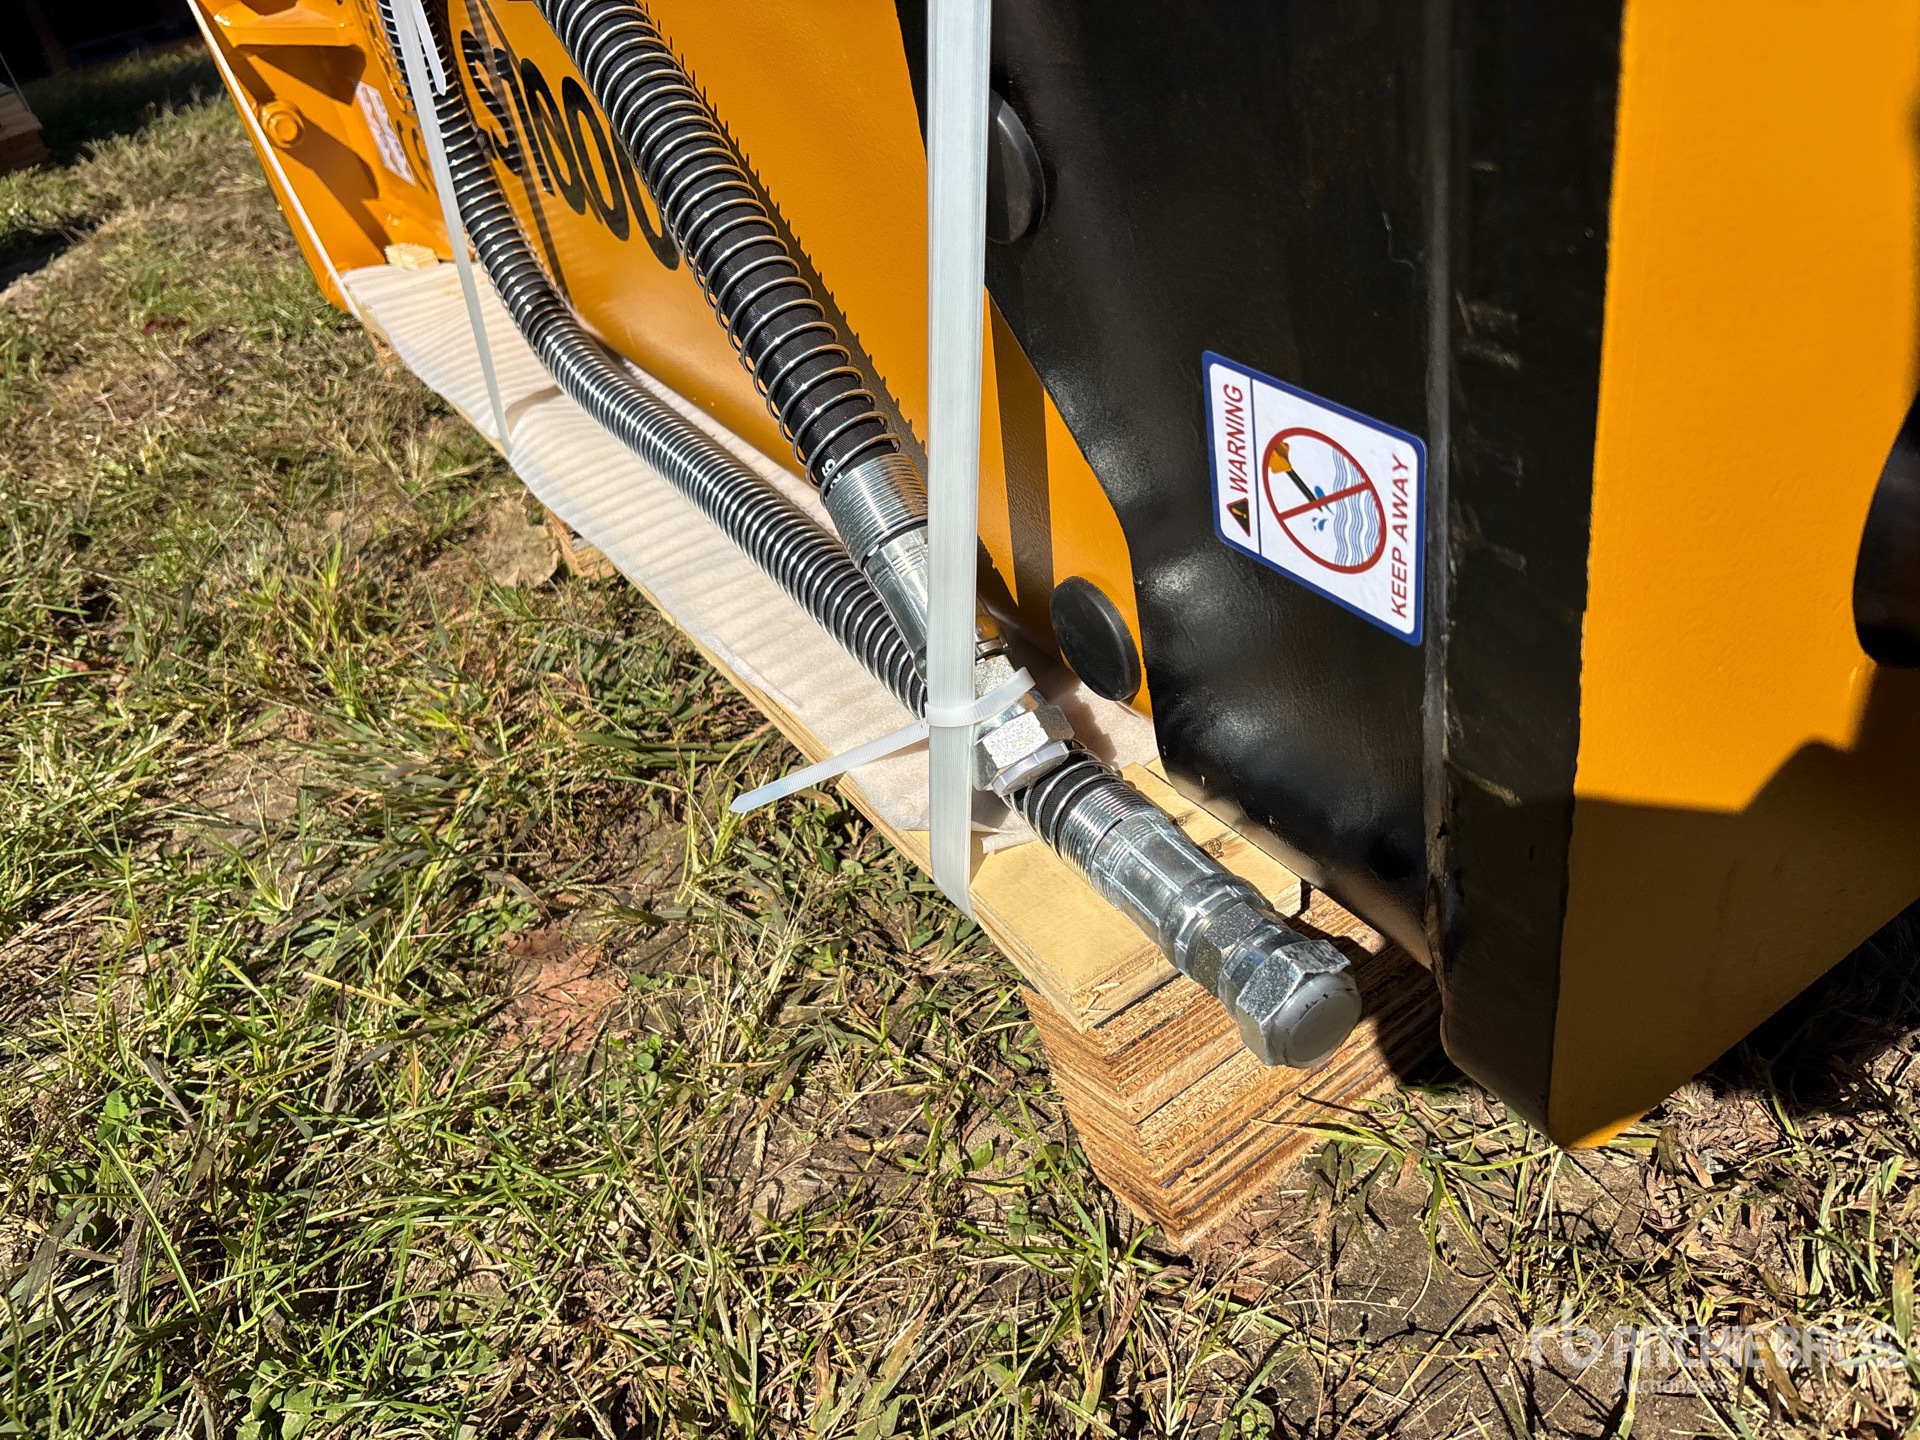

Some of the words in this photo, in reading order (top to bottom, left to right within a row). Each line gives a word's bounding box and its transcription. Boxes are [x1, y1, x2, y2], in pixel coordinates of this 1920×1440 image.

[1223, 384, 1249, 493] WARNING
[1391, 454, 1409, 543] AWAY
[1391, 547, 1408, 618] KEEP
